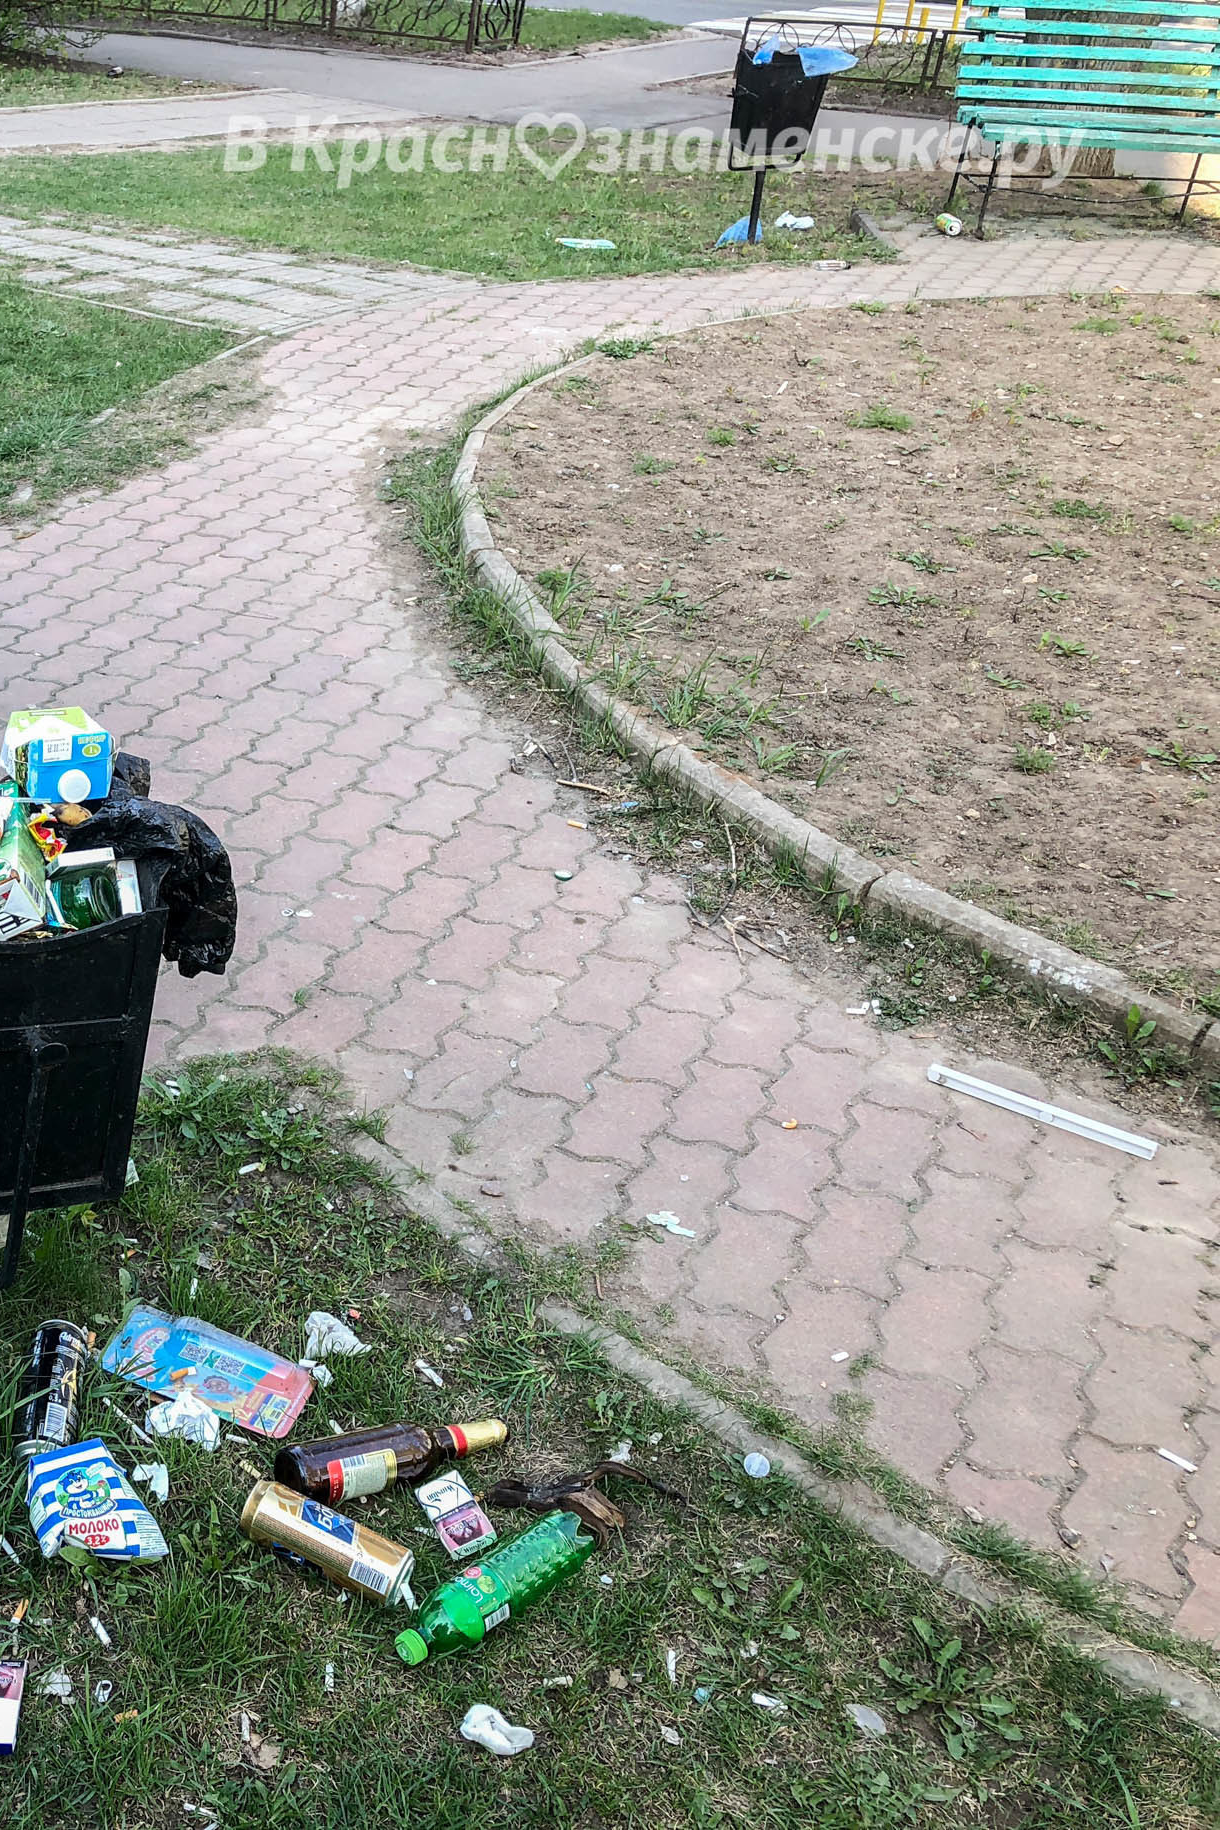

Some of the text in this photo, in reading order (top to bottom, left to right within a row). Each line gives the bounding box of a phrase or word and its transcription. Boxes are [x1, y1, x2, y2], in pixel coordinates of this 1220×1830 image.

[426, 1484, 455, 1501] Winston
[68, 1518, 120, 1535] МОЛОКО
[463, 1540, 487, 1553] Winston
